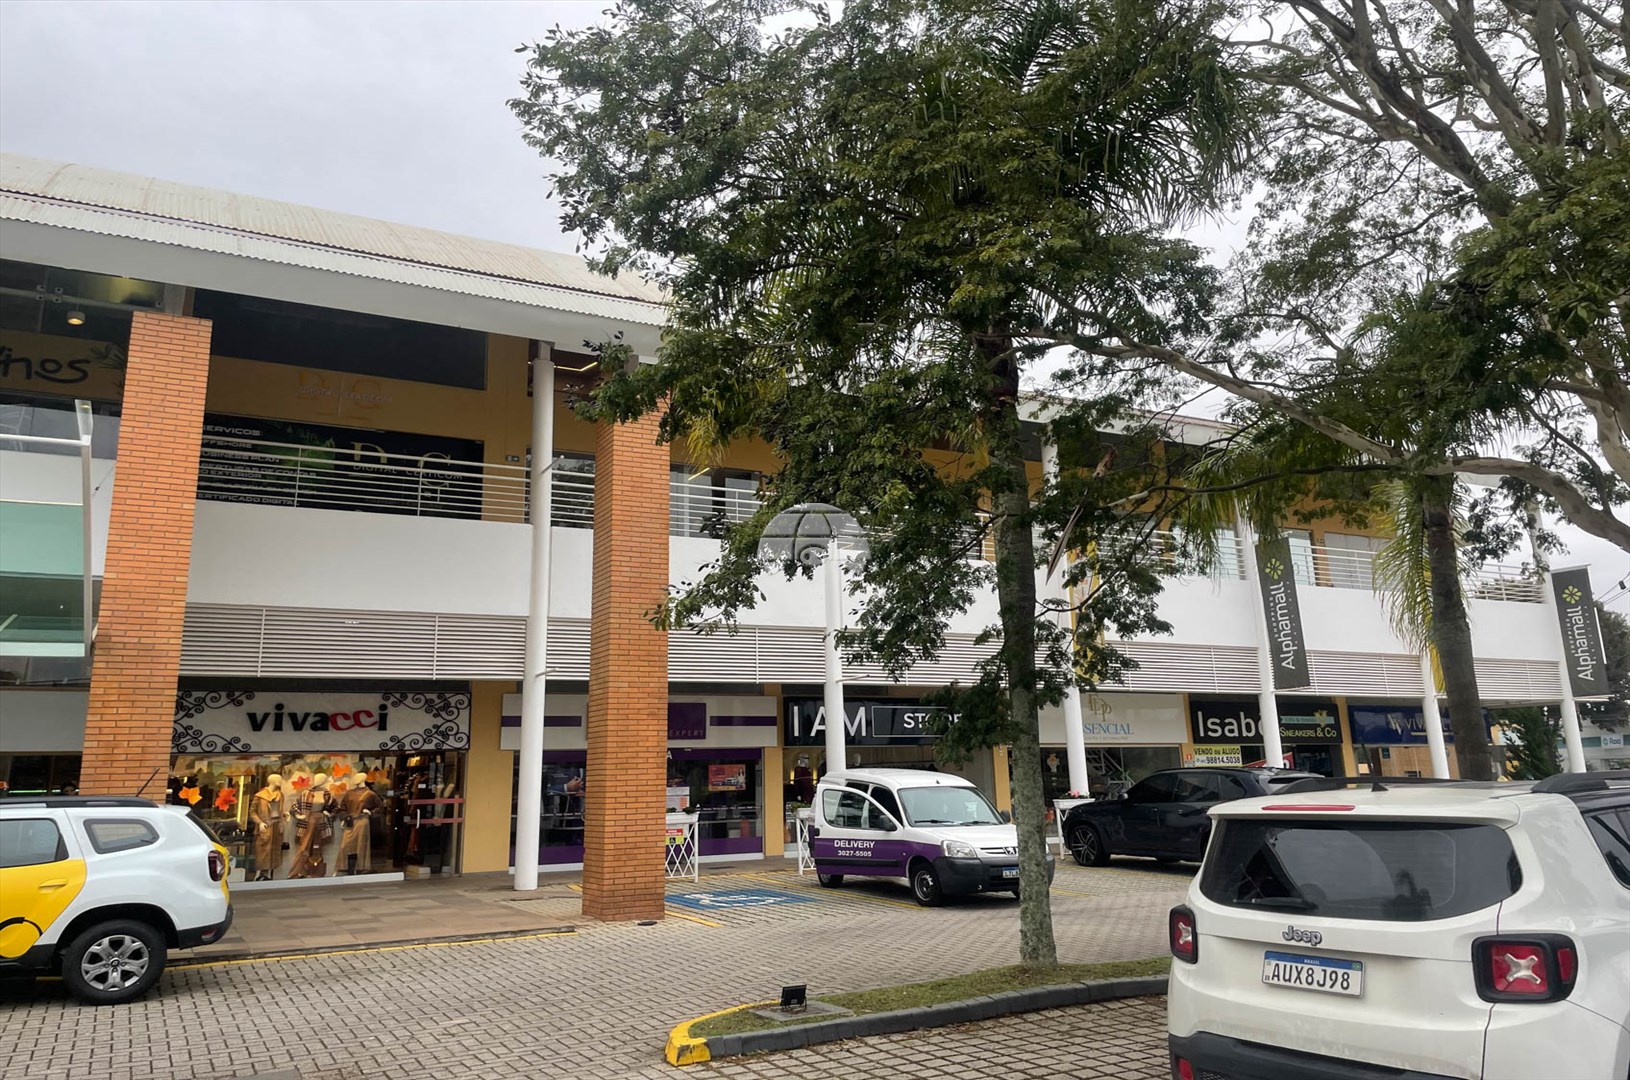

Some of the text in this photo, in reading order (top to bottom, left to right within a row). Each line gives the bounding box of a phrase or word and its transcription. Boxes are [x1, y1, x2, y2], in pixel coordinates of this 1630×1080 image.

[1269, 581, 1298, 670] Alphamall
[1566, 605, 1597, 681] Alphamall
[246, 703, 388, 731] vivacci
[793, 705, 799, 737] I
[1197, 710, 1264, 737] Isab
[1193, 747, 1213, 755] VENDO
[1222, 747, 1240, 755] ALUGO
[834, 840, 875, 848] DELIVERY
[1282, 925, 1323, 947] Jeep
[1271, 963, 1350, 991] AUX8J98
